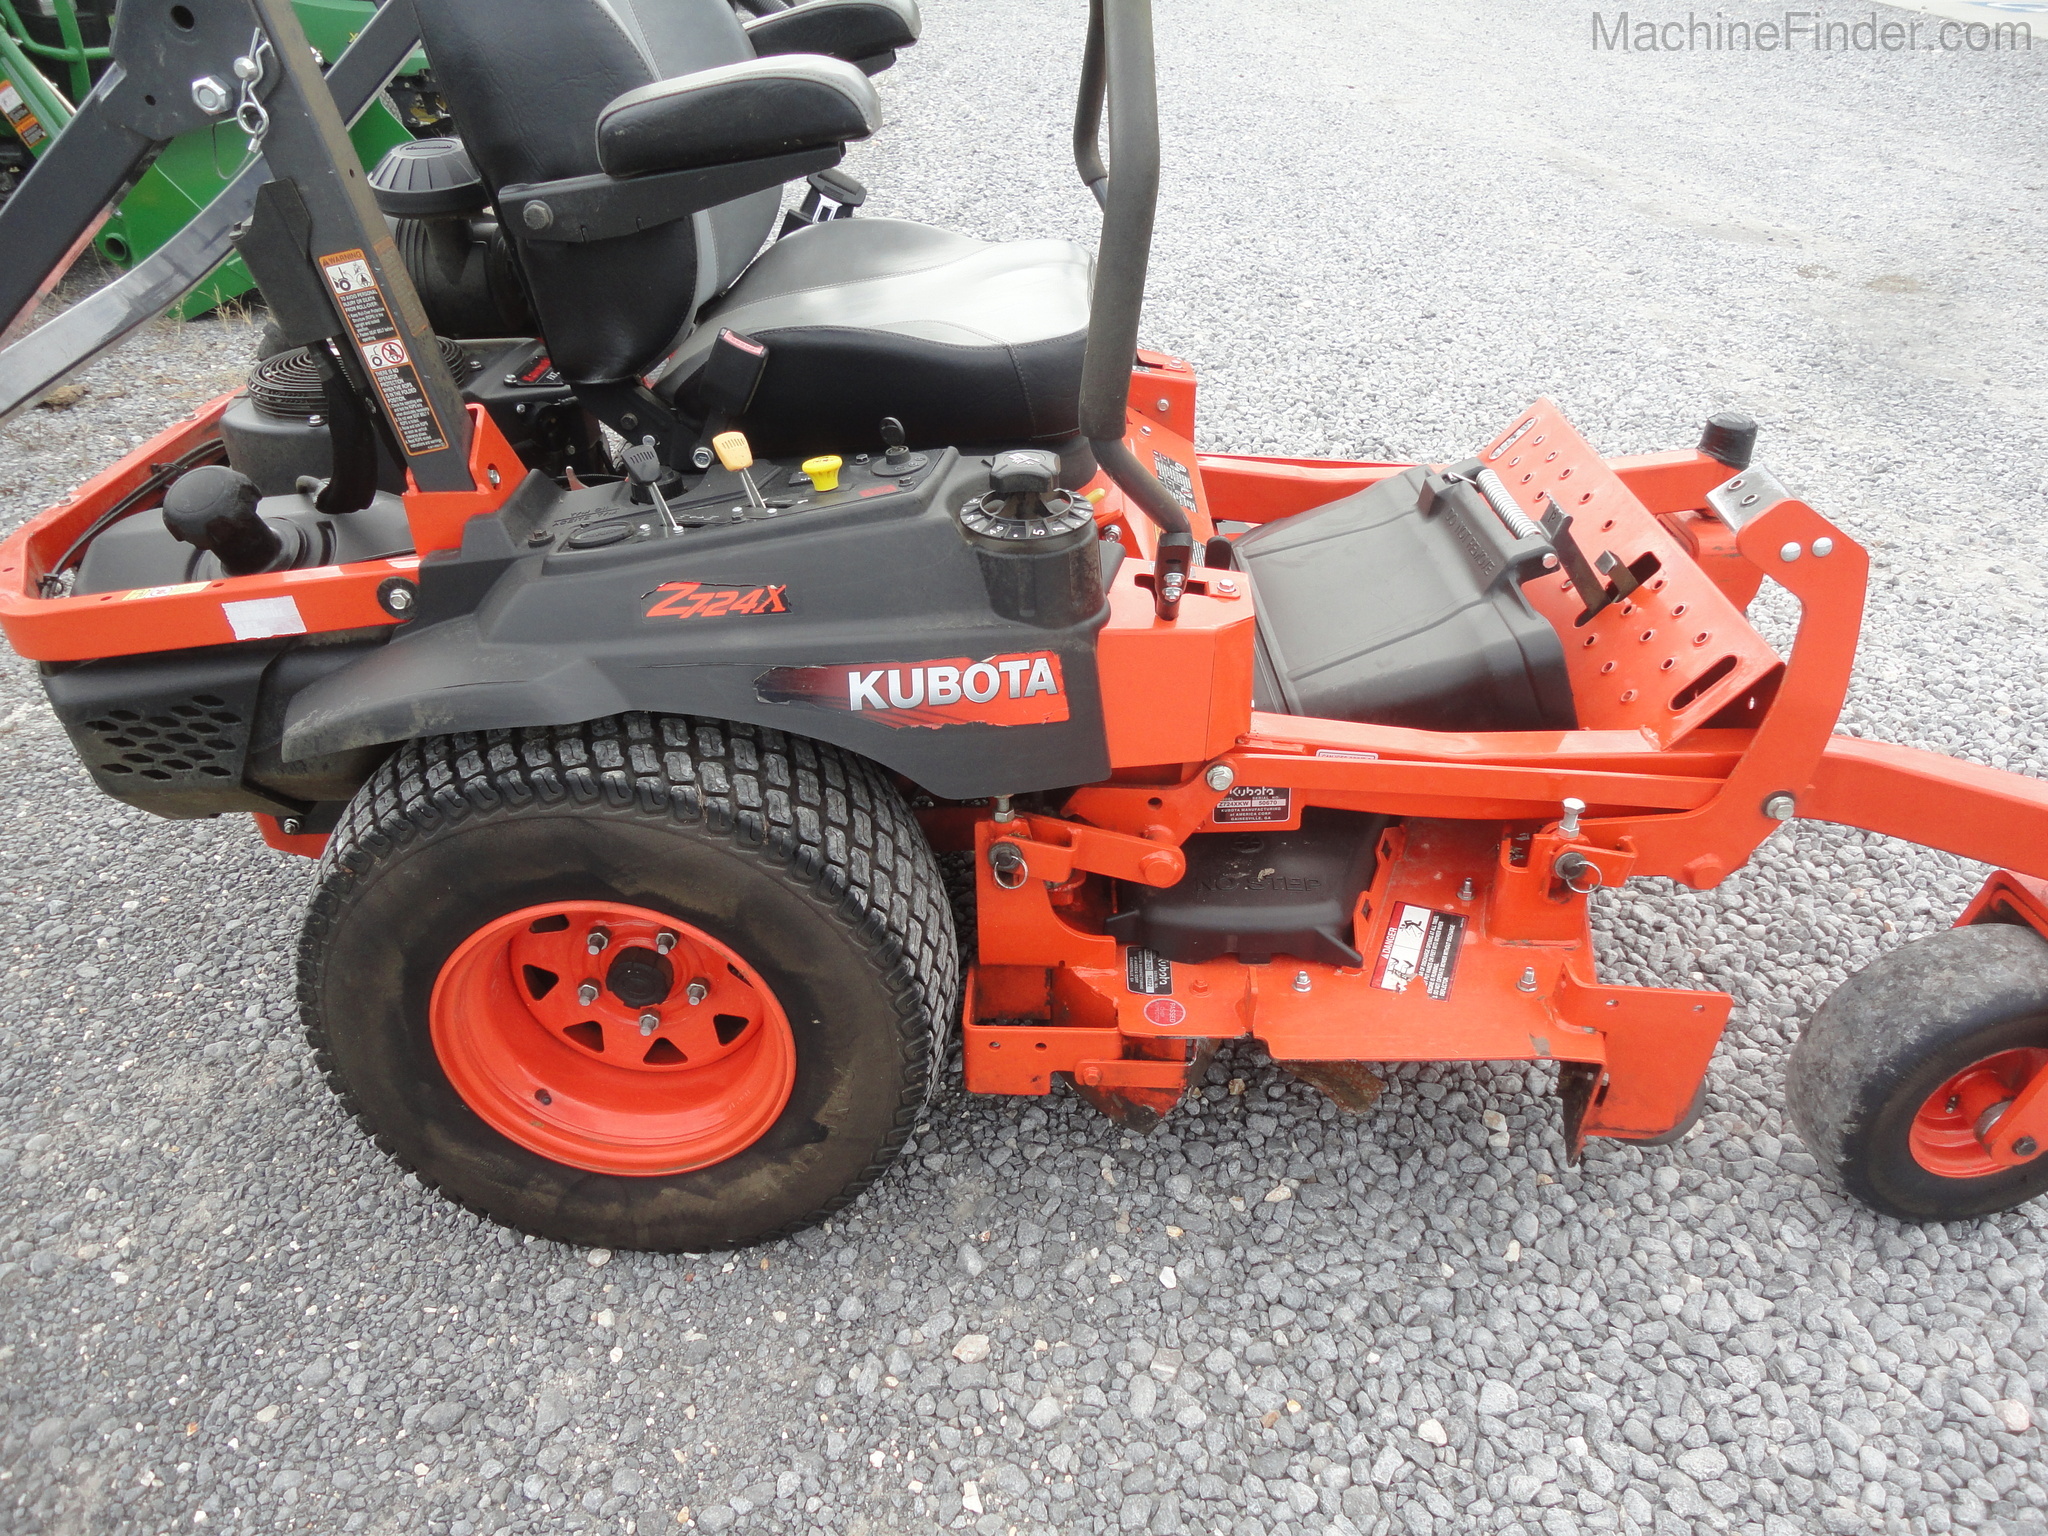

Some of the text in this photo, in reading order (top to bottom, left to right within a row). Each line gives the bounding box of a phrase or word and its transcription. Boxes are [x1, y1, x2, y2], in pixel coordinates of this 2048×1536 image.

[329, 252, 361, 263] WARNING
[645, 582, 787, 618] Z724X
[848, 657, 1058, 712] KUBOTA
[1230, 786, 1274, 796] Kubota
[1195, 876, 1322, 892] NO STEP
[1383, 927, 1397, 954] DANGER
